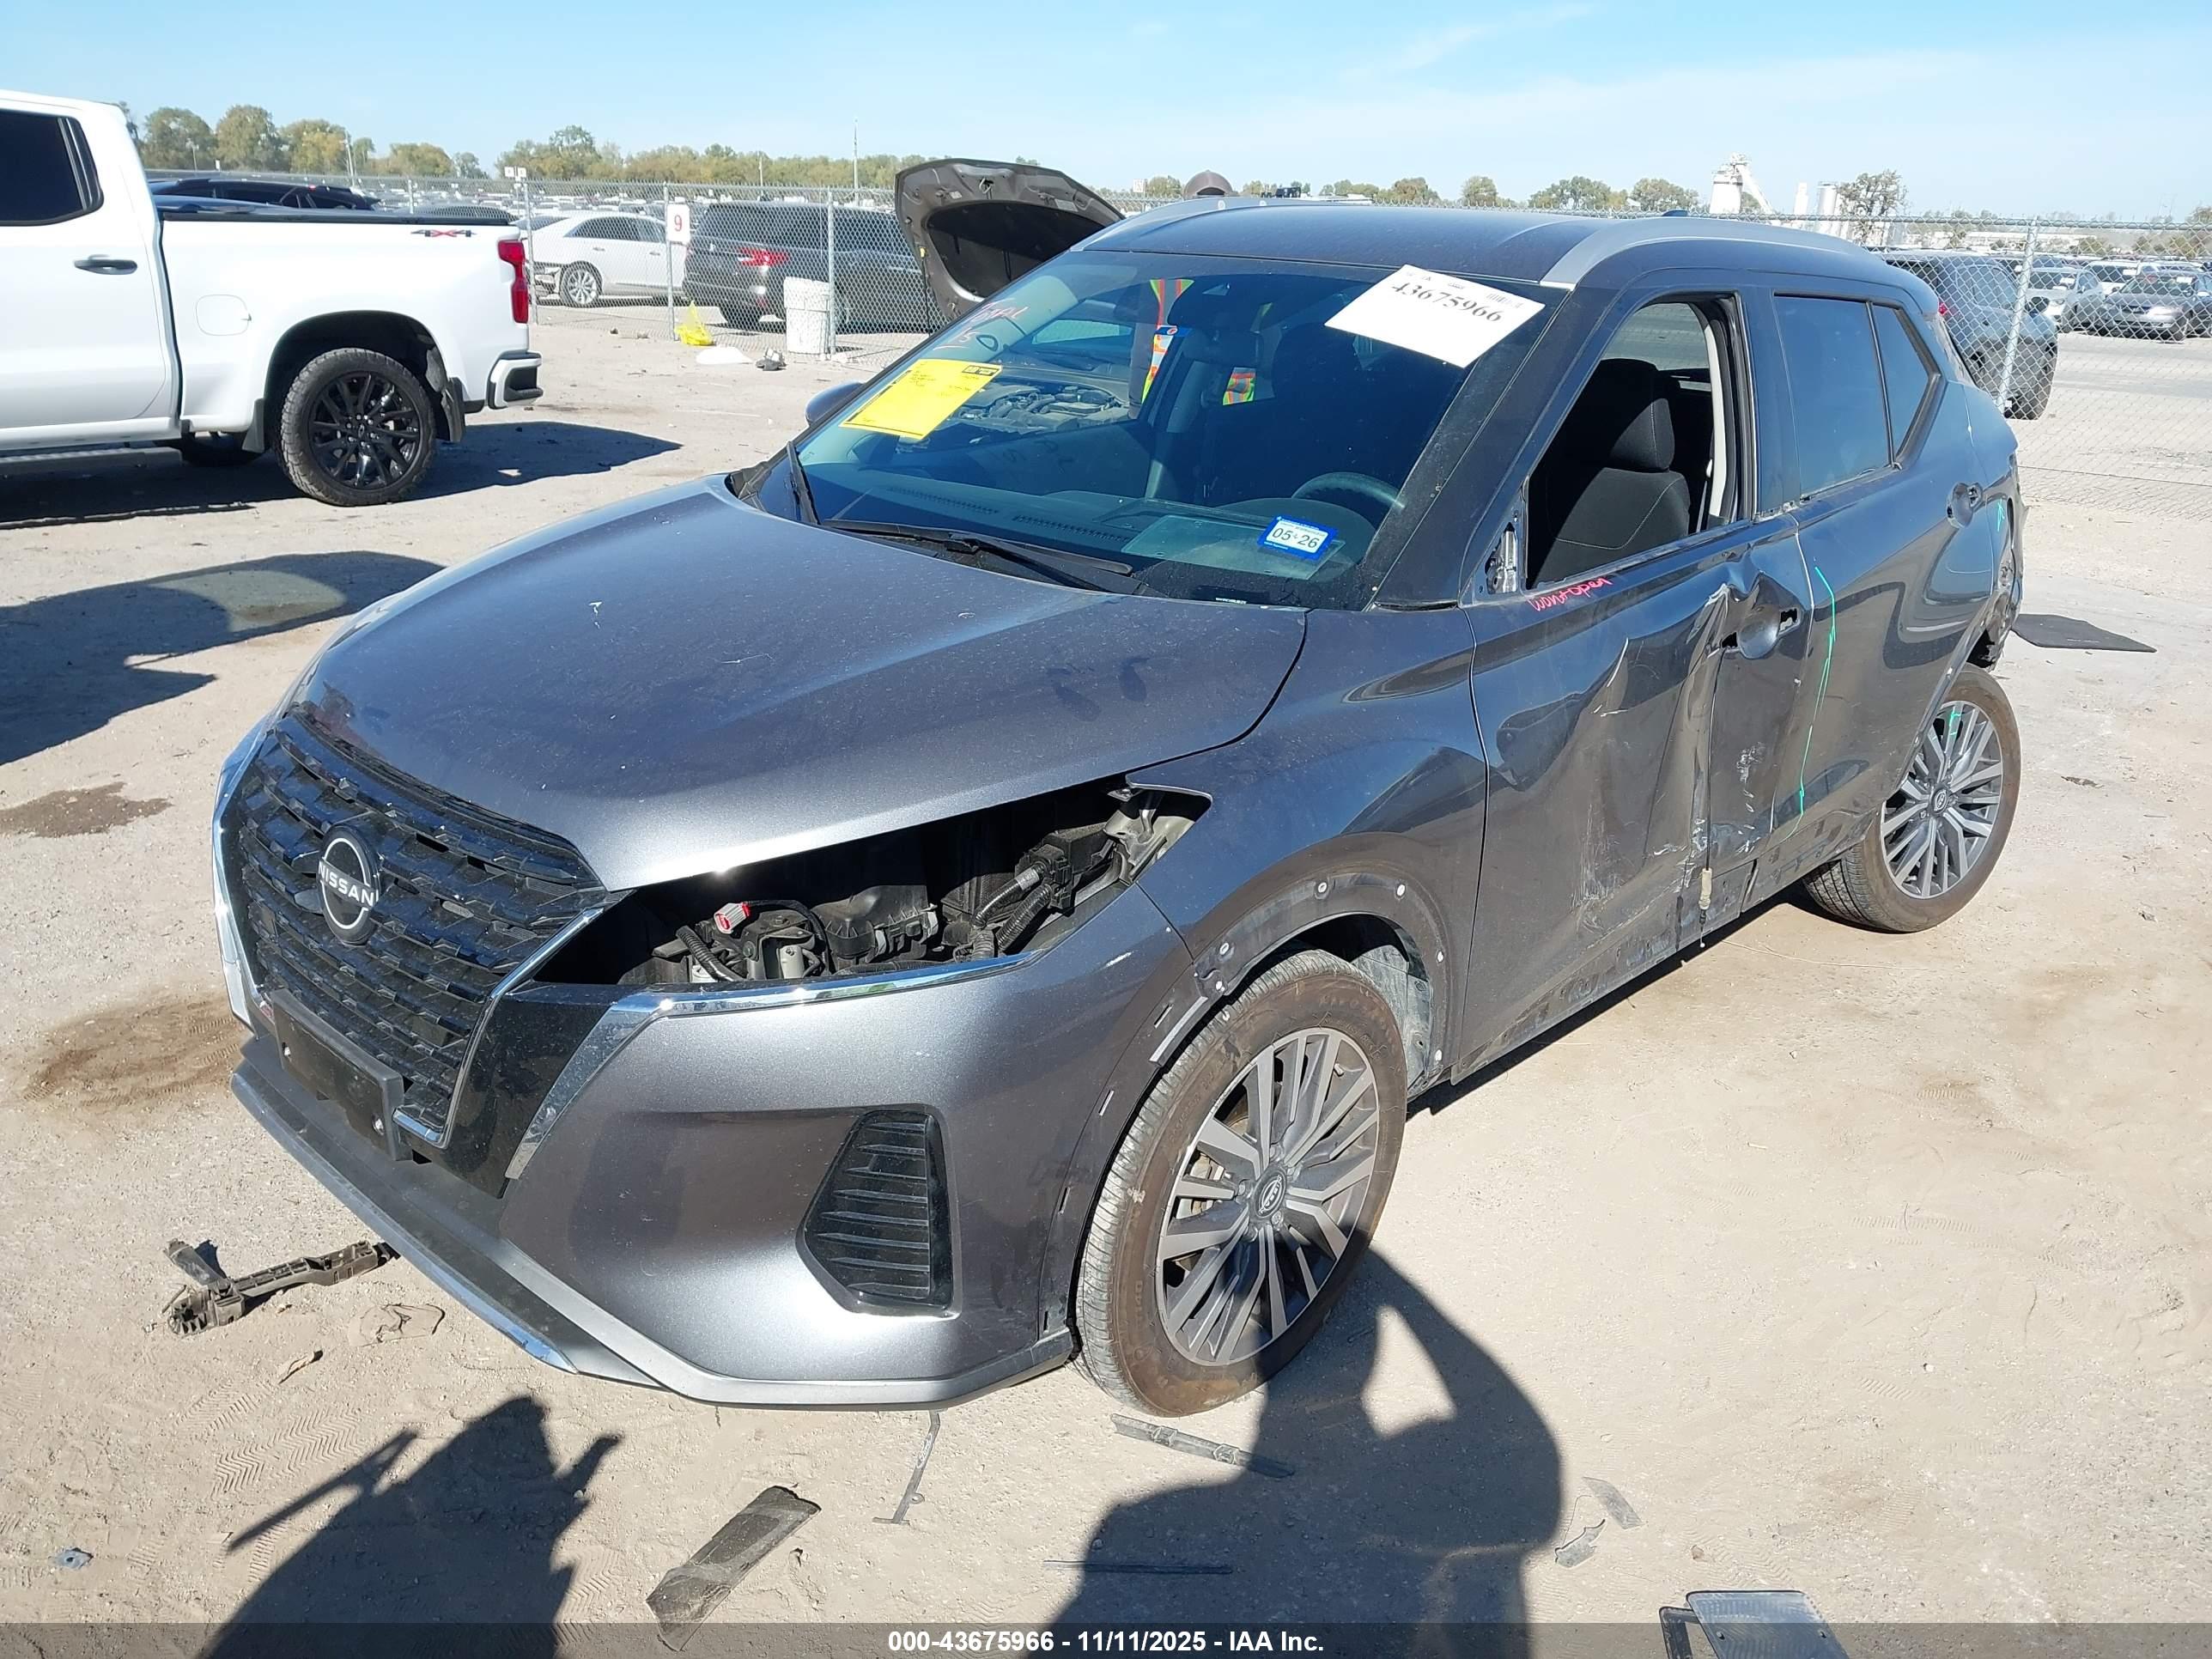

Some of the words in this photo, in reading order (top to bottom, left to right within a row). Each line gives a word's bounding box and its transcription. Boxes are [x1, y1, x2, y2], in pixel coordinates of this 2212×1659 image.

[673, 214, 683, 232] 9
[1392, 283, 1503, 321] 43675966
[1272, 527, 1293, 541] 05
[1297, 534, 1320, 549] 26
[318, 860, 374, 907] NISSAN
